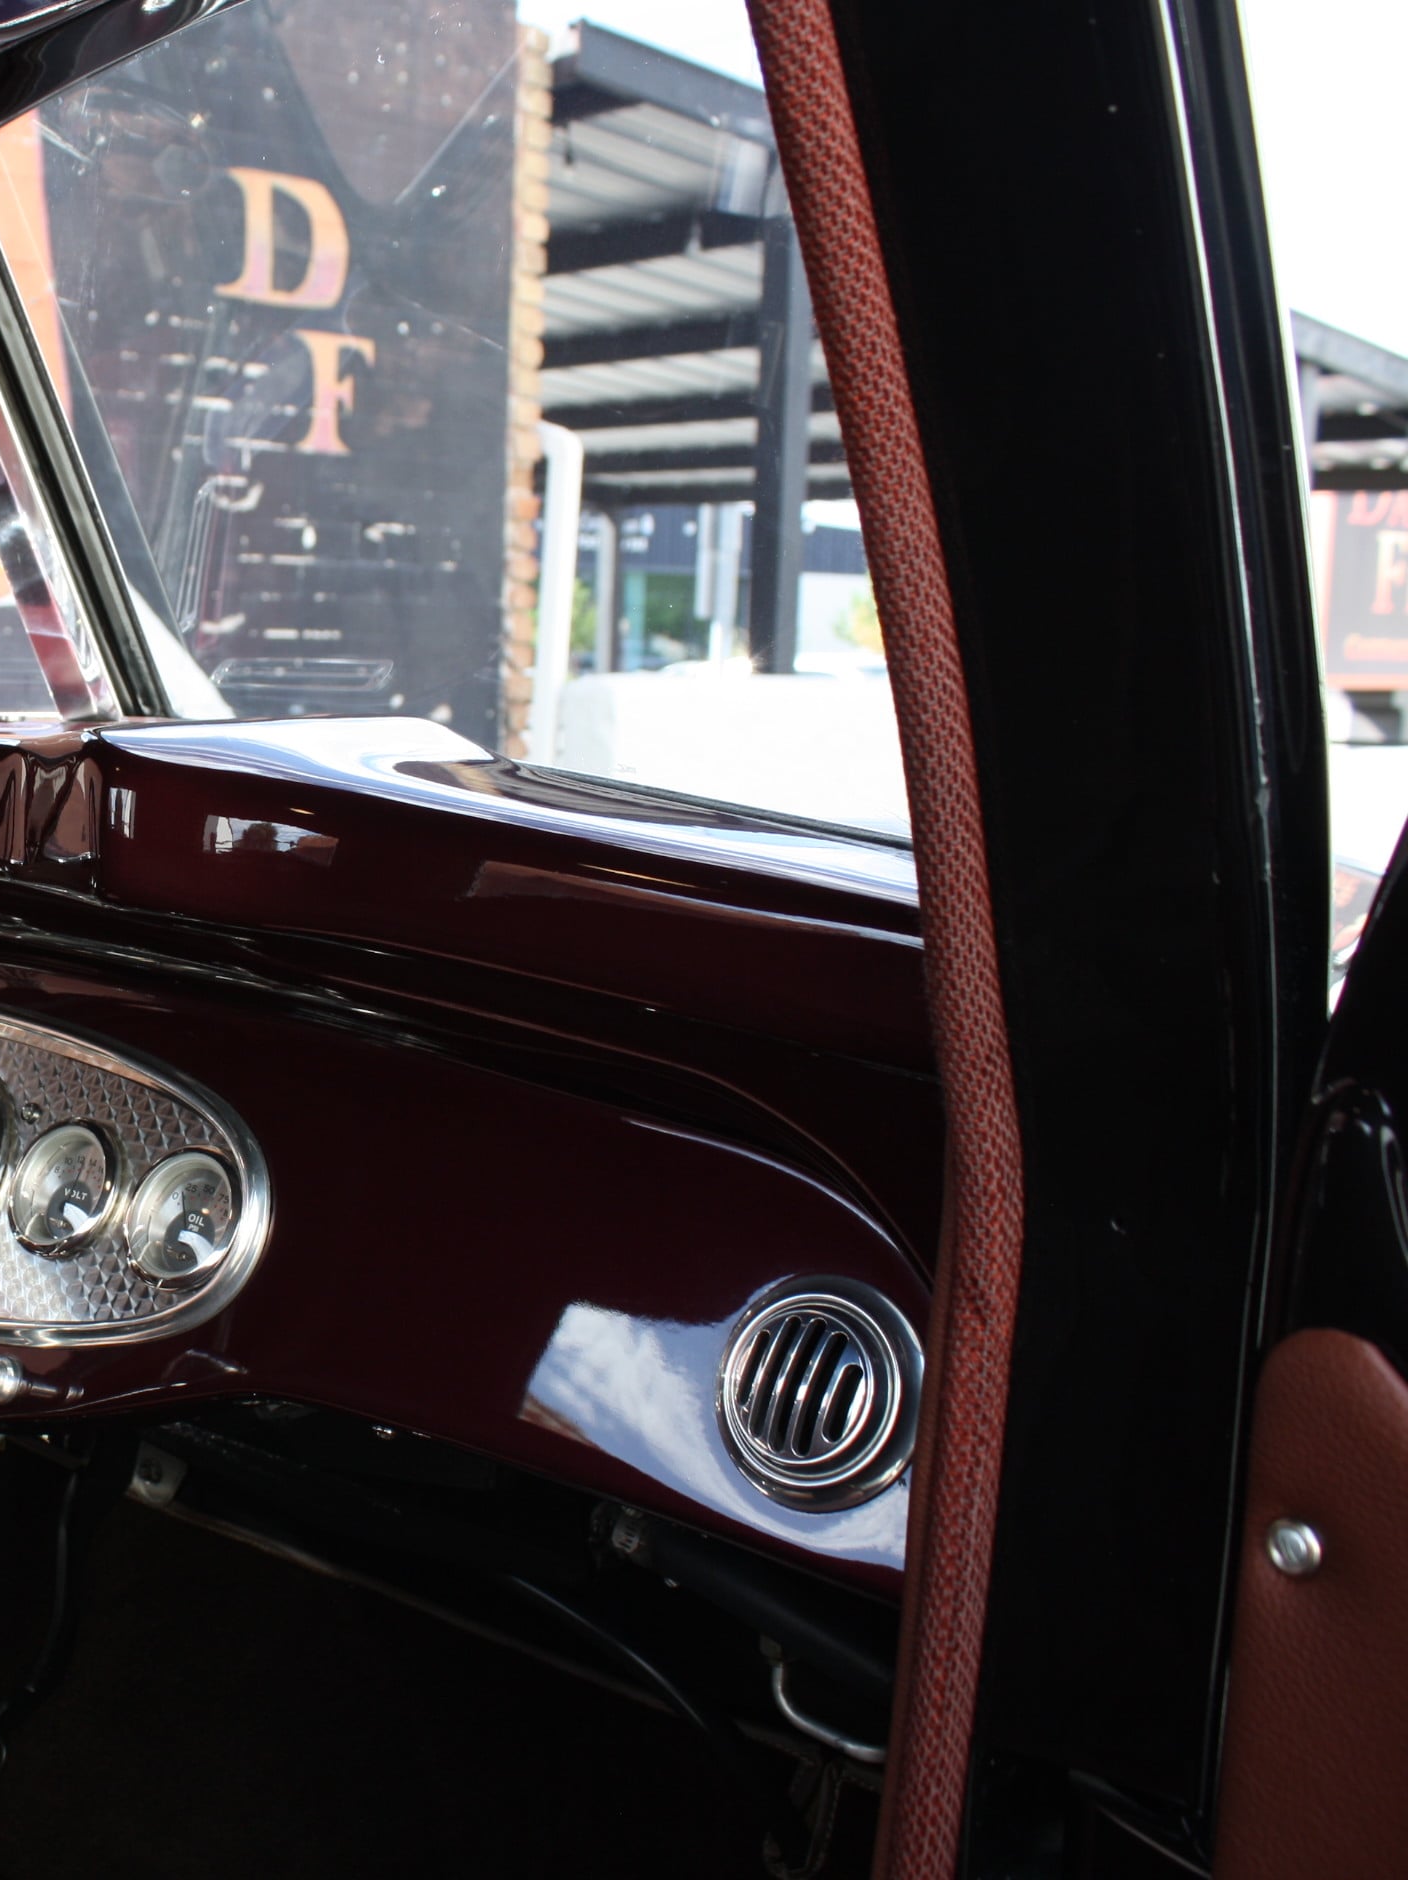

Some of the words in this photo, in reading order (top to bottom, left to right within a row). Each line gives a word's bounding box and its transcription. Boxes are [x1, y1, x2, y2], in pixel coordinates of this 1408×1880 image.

[214, 167, 350, 309] D
[294, 330, 376, 456] F
[64, 1188, 88, 1201] VOLT
[185, 1183, 198, 1193] 25
[203, 1184, 215, 1195] 50
[188, 1213, 205, 1227] OIL
